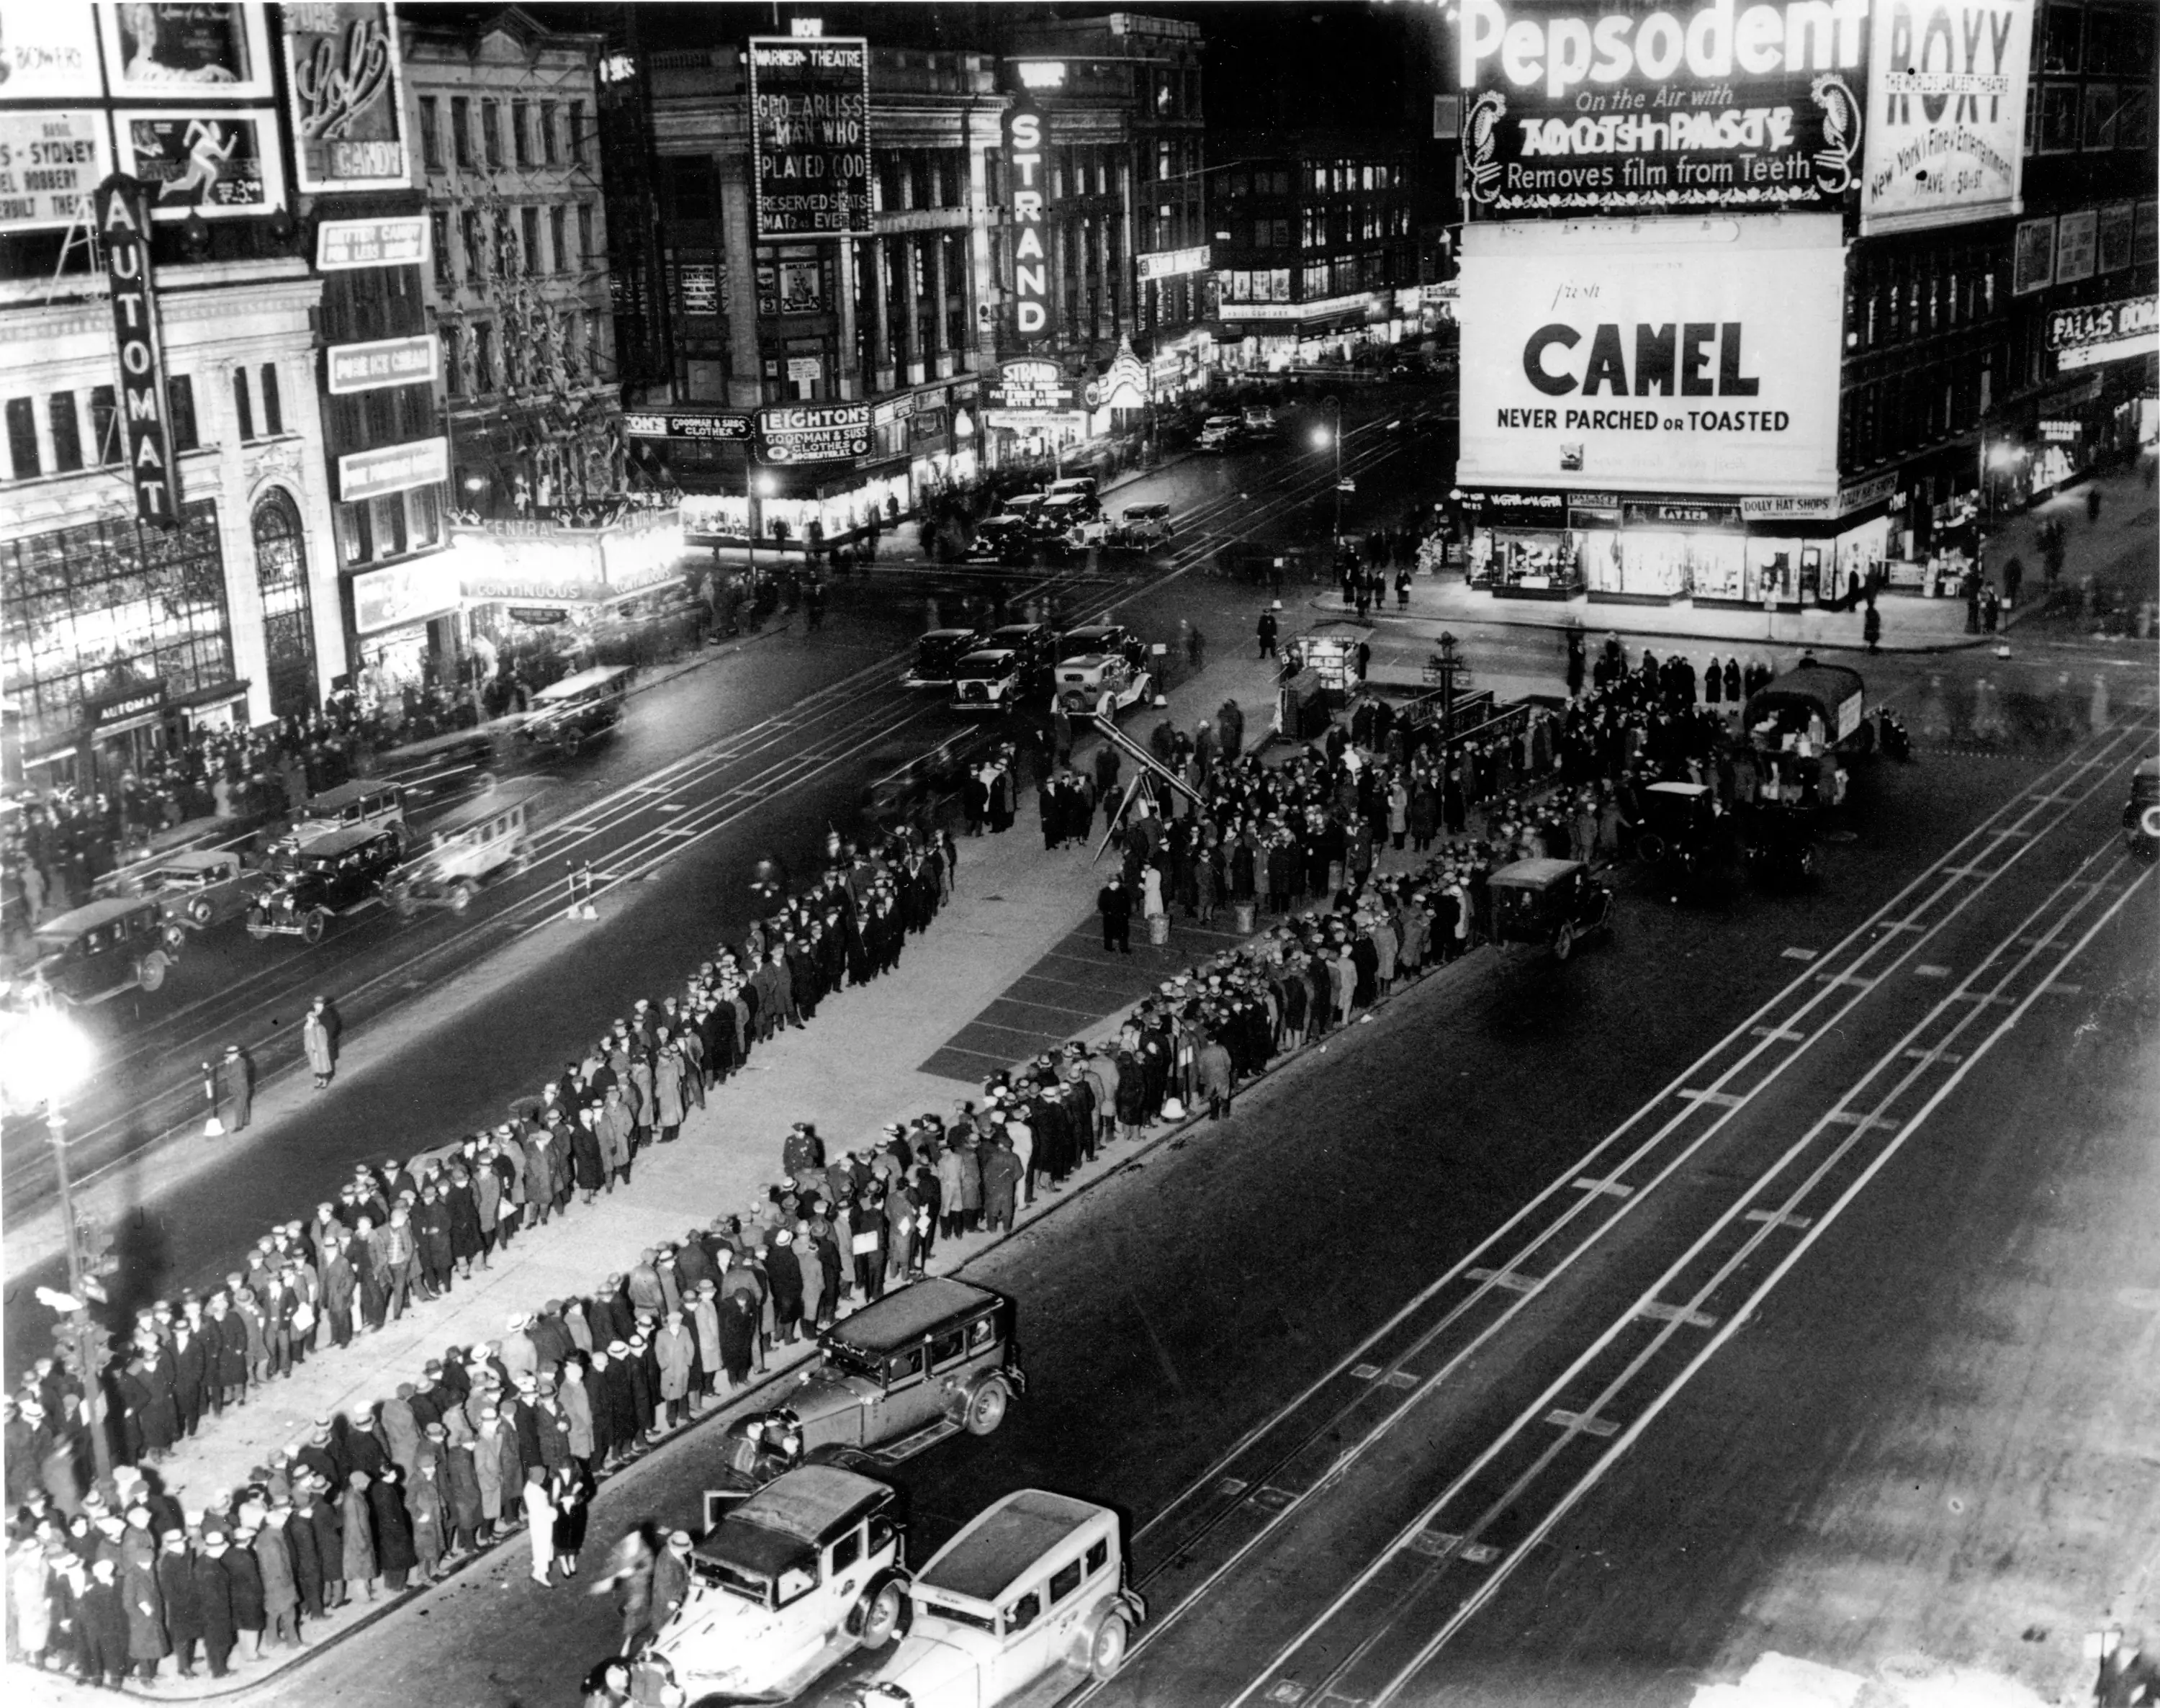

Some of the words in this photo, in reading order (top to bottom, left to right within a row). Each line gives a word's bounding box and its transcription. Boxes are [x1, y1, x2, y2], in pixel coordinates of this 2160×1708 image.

[810, 49, 862, 67] THEATRE
[1459, 1, 1870, 98] Pepsodent
[802, 94, 863, 118] ARLISS
[1575, 91, 1606, 112] On
[1612, 88, 1645, 109] the
[1653, 86, 1687, 108] Air
[1691, 84, 1733, 106] with
[775, 121, 815, 145] MAN
[822, 120, 859, 144] WHO
[30, 139, 95, 165] SYDNEY
[337, 142, 400, 176] CANDY
[762, 154, 824, 178] PLAYED
[1508, 161, 1614, 189] Removes
[1624, 158, 1668, 186] film
[1676, 154, 1733, 184] from
[1741, 150, 1811, 181] Teeth
[762, 194, 828, 212] RESERVED
[1011, 114, 1046, 333] STRAND
[105, 189, 165, 515] AUTOMAT
[1523, 322, 1760, 396] CAMEL
[1003, 362, 1058, 382] STRAND
[761, 406, 870, 434] LEIGHTON'S
[1498, 408, 1557, 428] NEVER
[1565, 410, 1659, 431] PARCHED
[1664, 417, 1683, 431] OR
[1688, 410, 1789, 432] TOASTED
[766, 431, 831, 445] GOODMAN
[833, 430, 842, 441] &
[844, 427, 868, 441] SUSS
[792, 440, 850, 453] CLOTHES
[1744, 500, 1773, 512] DOLLY
[1776, 498, 1794, 511] HAT
[1796, 498, 1830, 511] SHOPS
[484, 520, 559, 538] CENTRAL
[478, 584, 579, 599] CONTINUOUS
[100, 693, 161, 719] AUTOMAT
